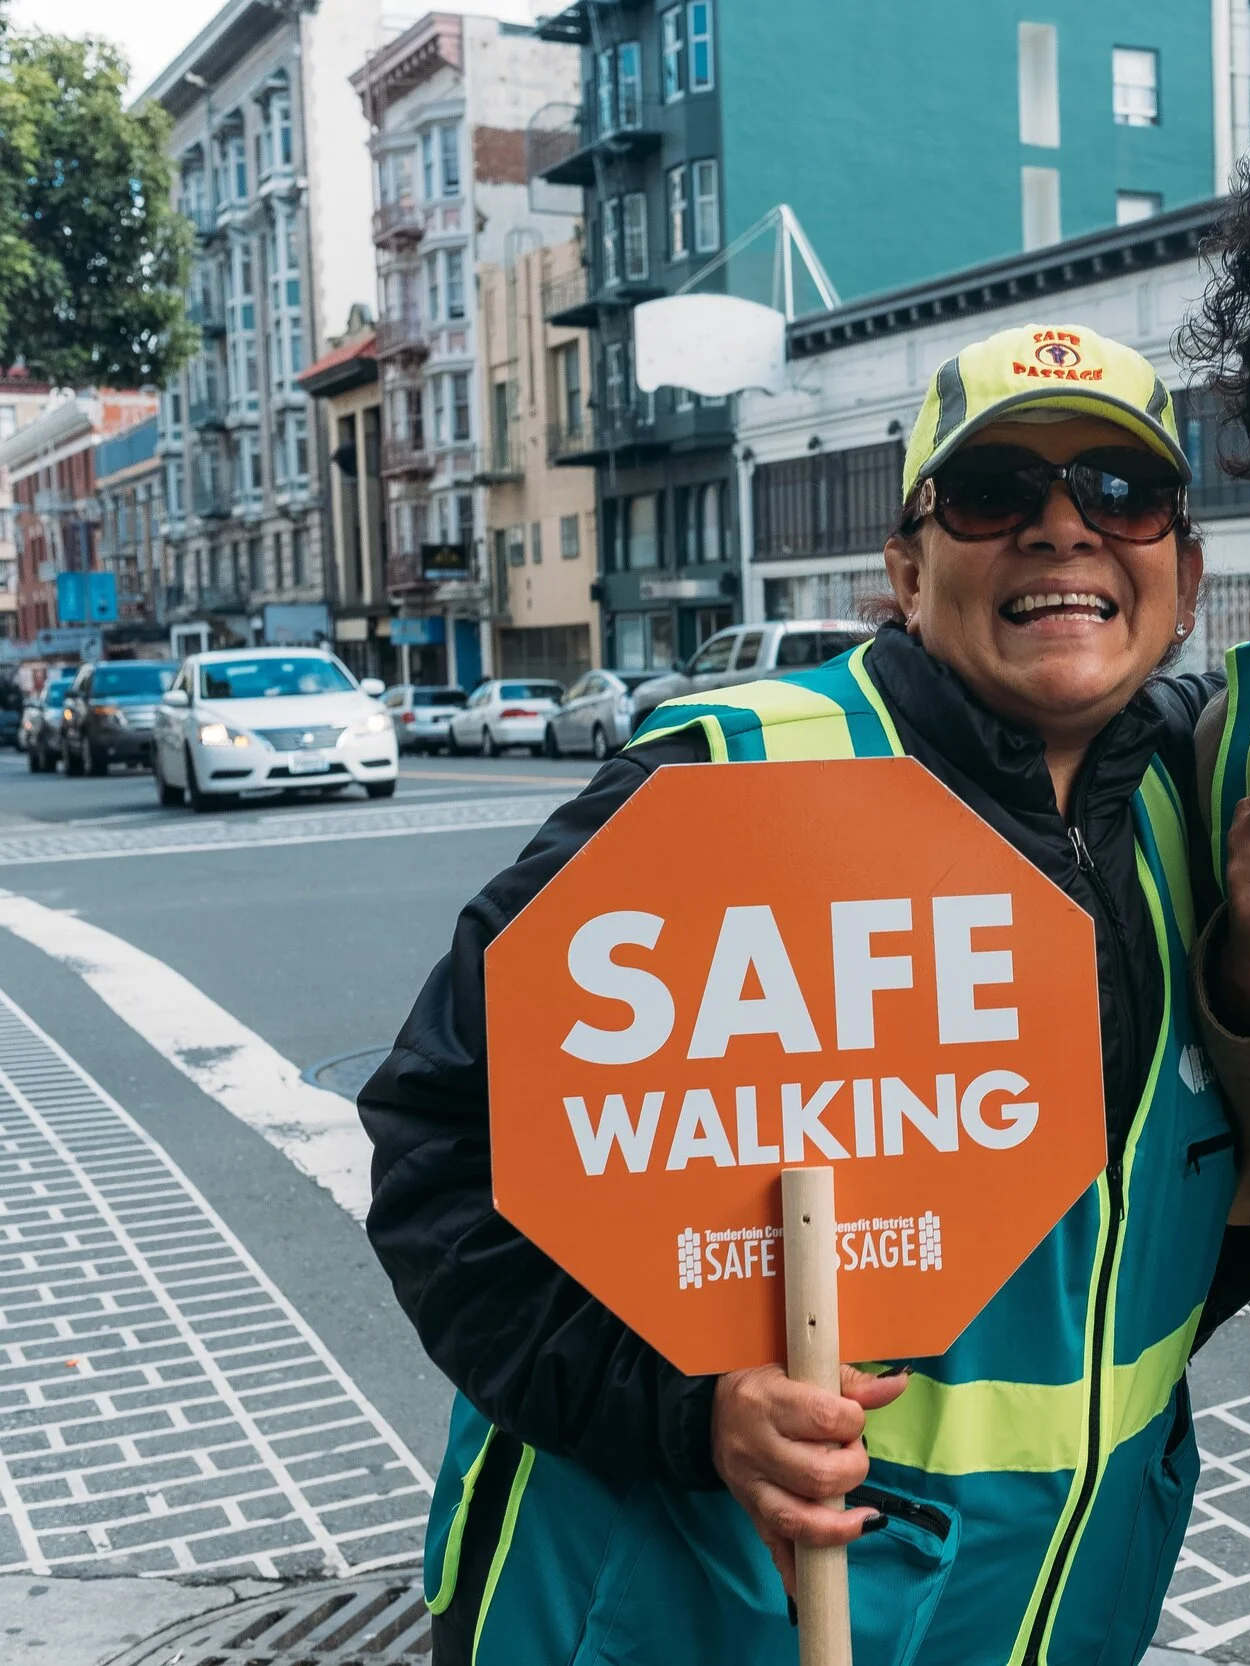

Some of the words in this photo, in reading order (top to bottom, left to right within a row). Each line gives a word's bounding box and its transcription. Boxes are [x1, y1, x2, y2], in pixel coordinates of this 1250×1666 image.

[1033, 331, 1080, 346] SAFE
[1013, 362, 1103, 381] PASSAGE
[560, 893, 1020, 1065] SAFE
[563, 1069, 1039, 1176] WALKING
[704, 1226, 763, 1242] Tenderloin
[834, 1218, 871, 1234] enefit
[872, 1216, 914, 1231] District
[705, 1239, 777, 1281] SAFE
[834, 1229, 917, 1272] SAGE
